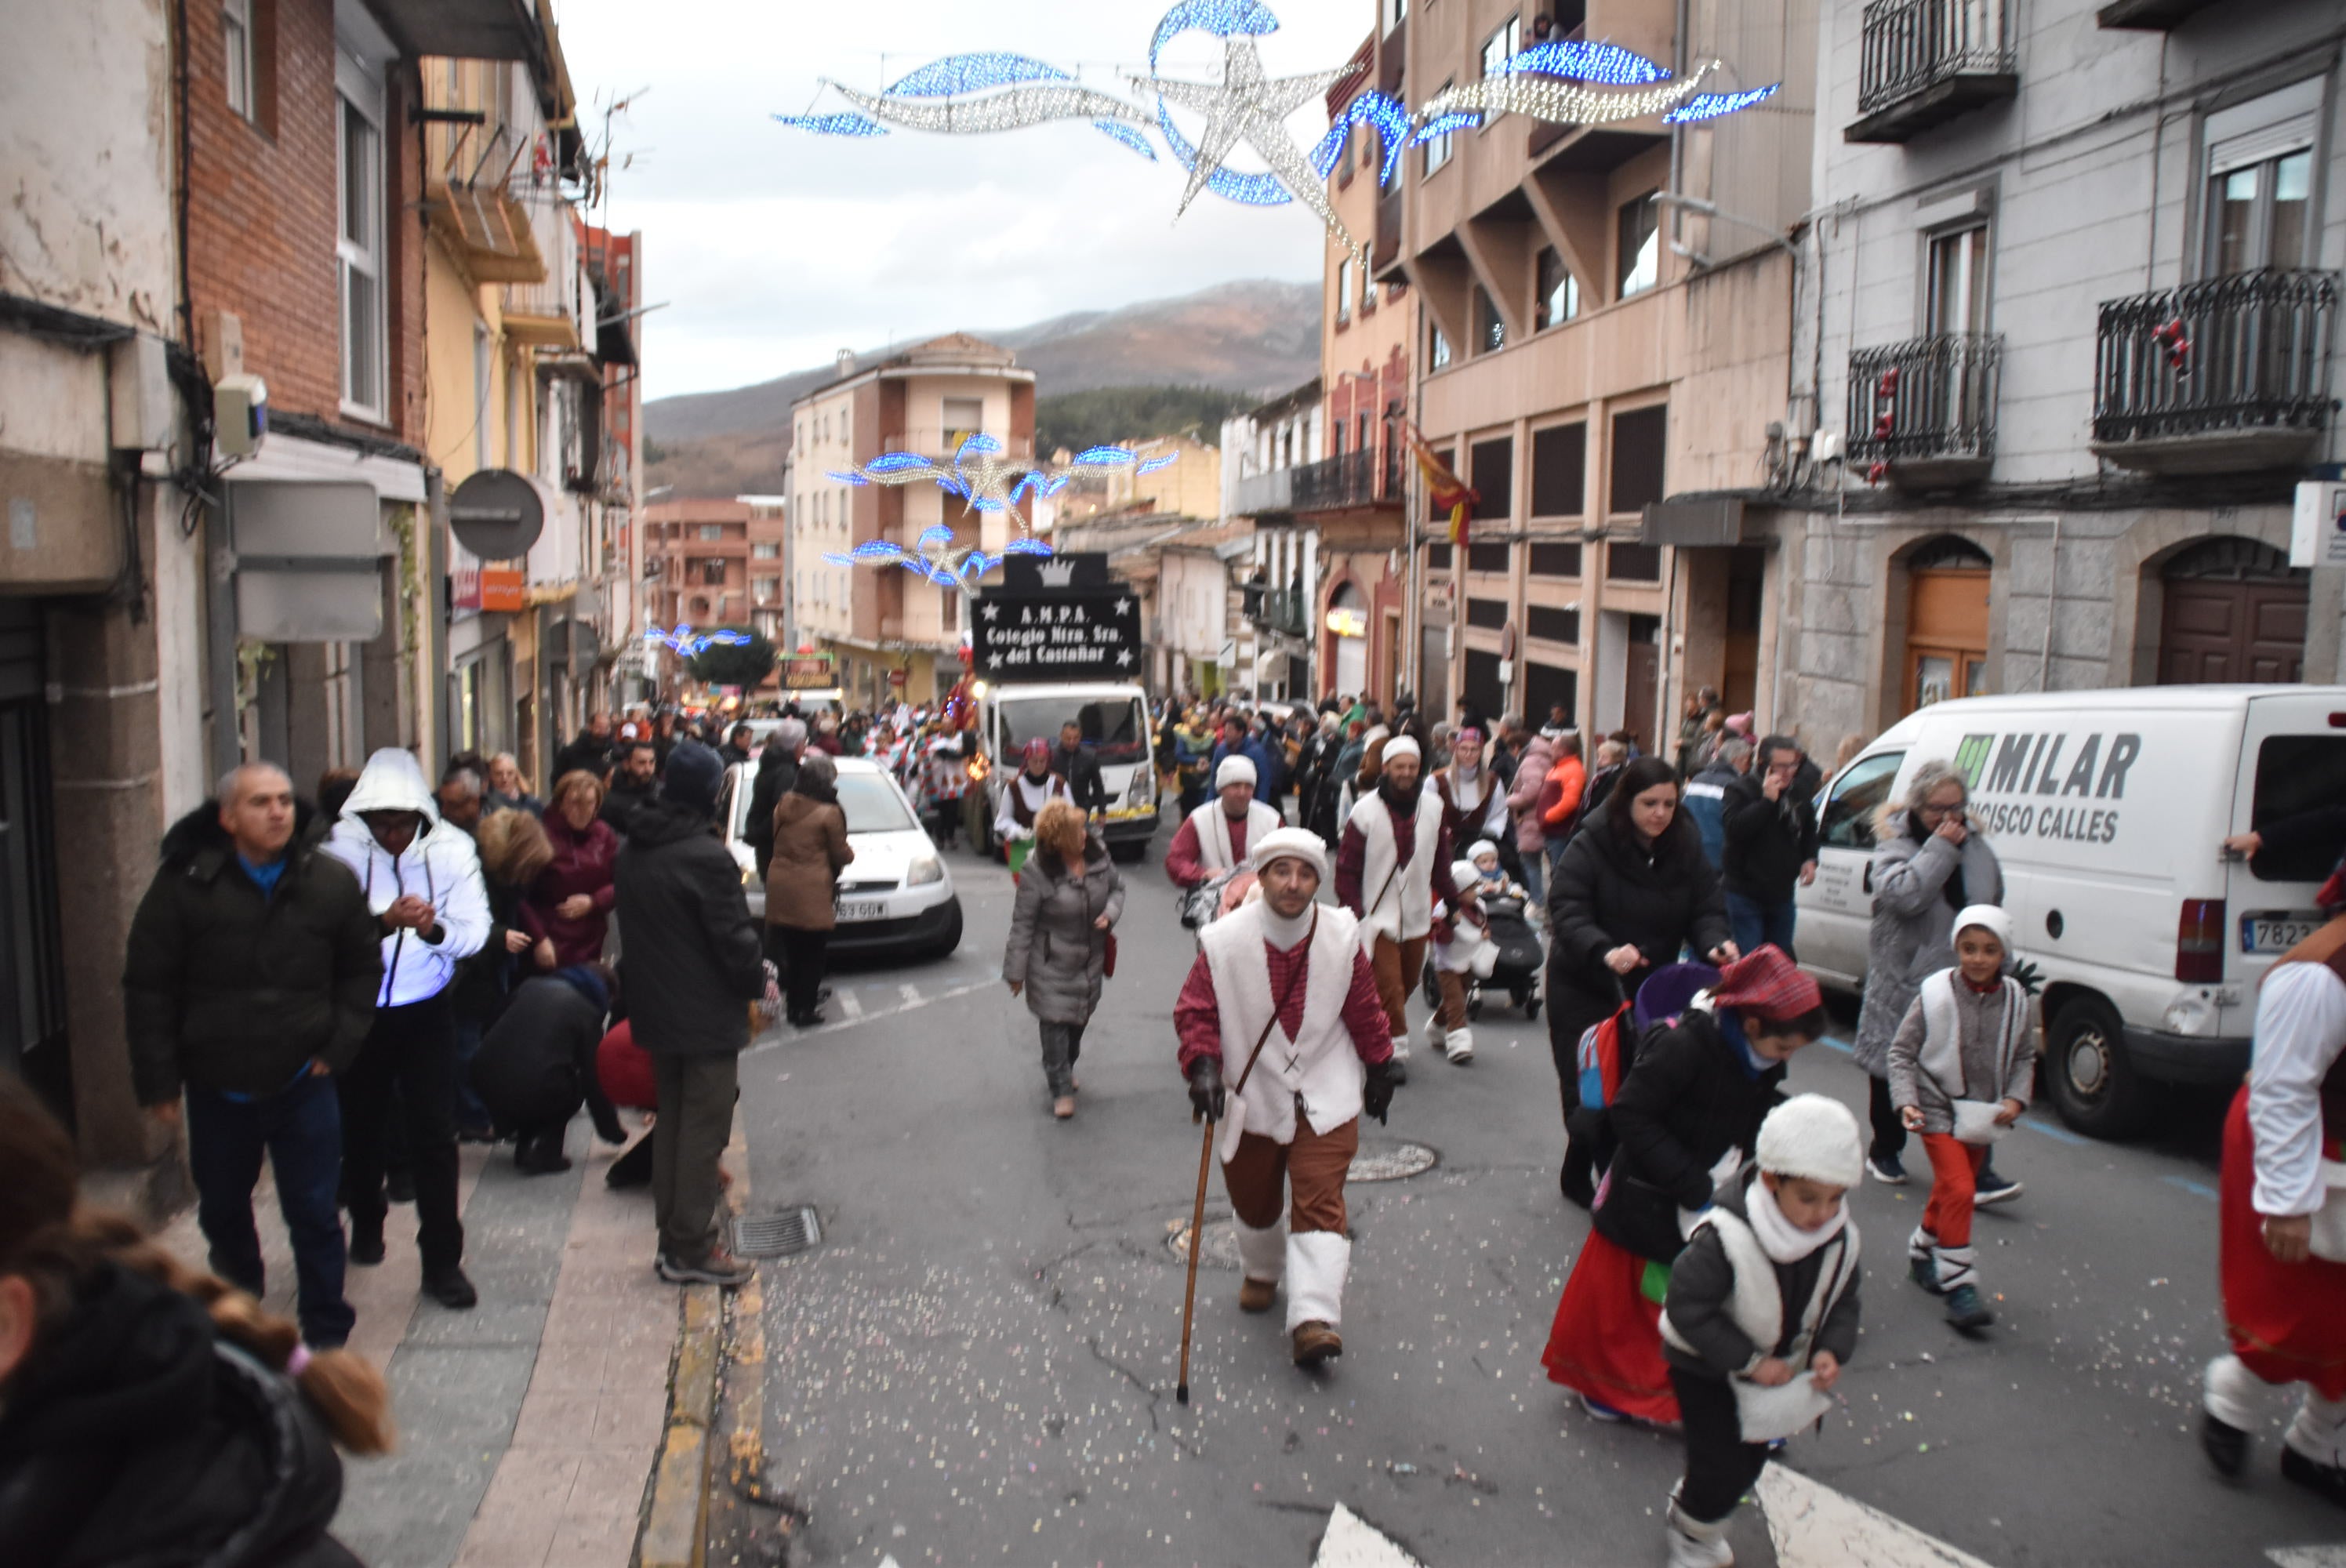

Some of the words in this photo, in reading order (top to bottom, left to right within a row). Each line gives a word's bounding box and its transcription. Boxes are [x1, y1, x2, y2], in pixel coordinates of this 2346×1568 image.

[986, 626, 1045, 647] Colegio
[1006, 646, 1031, 665] del
[1985, 731, 2141, 800] MILAR
[2037, 805, 2119, 845] CALLES
